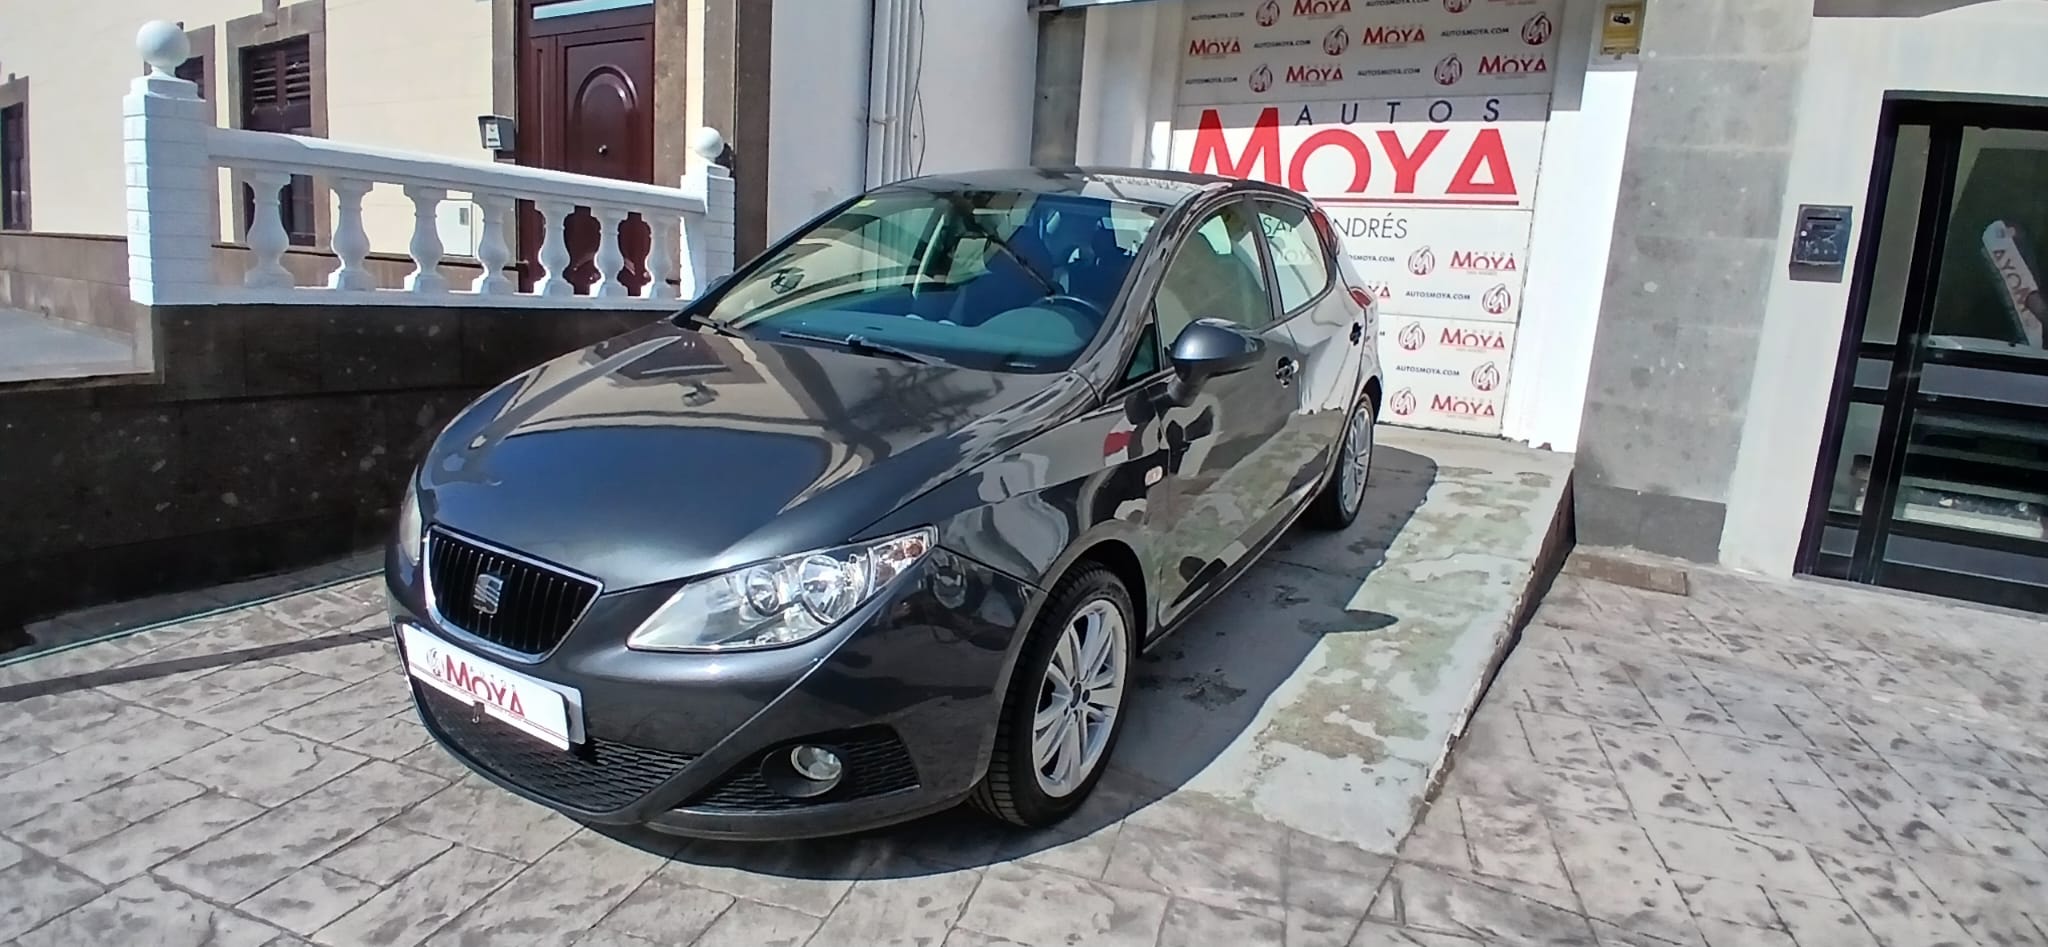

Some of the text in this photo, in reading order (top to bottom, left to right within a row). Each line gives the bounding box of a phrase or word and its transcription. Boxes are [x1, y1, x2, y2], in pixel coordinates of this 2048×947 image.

[1293, 0, 1351, 17] MOYA
[1363, 26, 1425, 45] MOYA
[1189, 39, 1241, 56] MOYA
[1286, 65, 1343, 83] MOYA
[1478, 55, 1547, 74] MOYA
[1295, 98, 1500, 126] AUTOS
[1188, 106, 1517, 195] MOYA
[1333, 212, 1408, 239] NDRÉS
[1450, 250, 1517, 271] MOYA
[1405, 290, 1471, 300] AUTOSMOYA.COM
[1440, 327, 1505, 348] MOYA
[1395, 364, 1460, 376] AUTOSMOYA.COM
[1430, 394, 1495, 416] MOYA
[445, 654, 525, 717] MOYA
